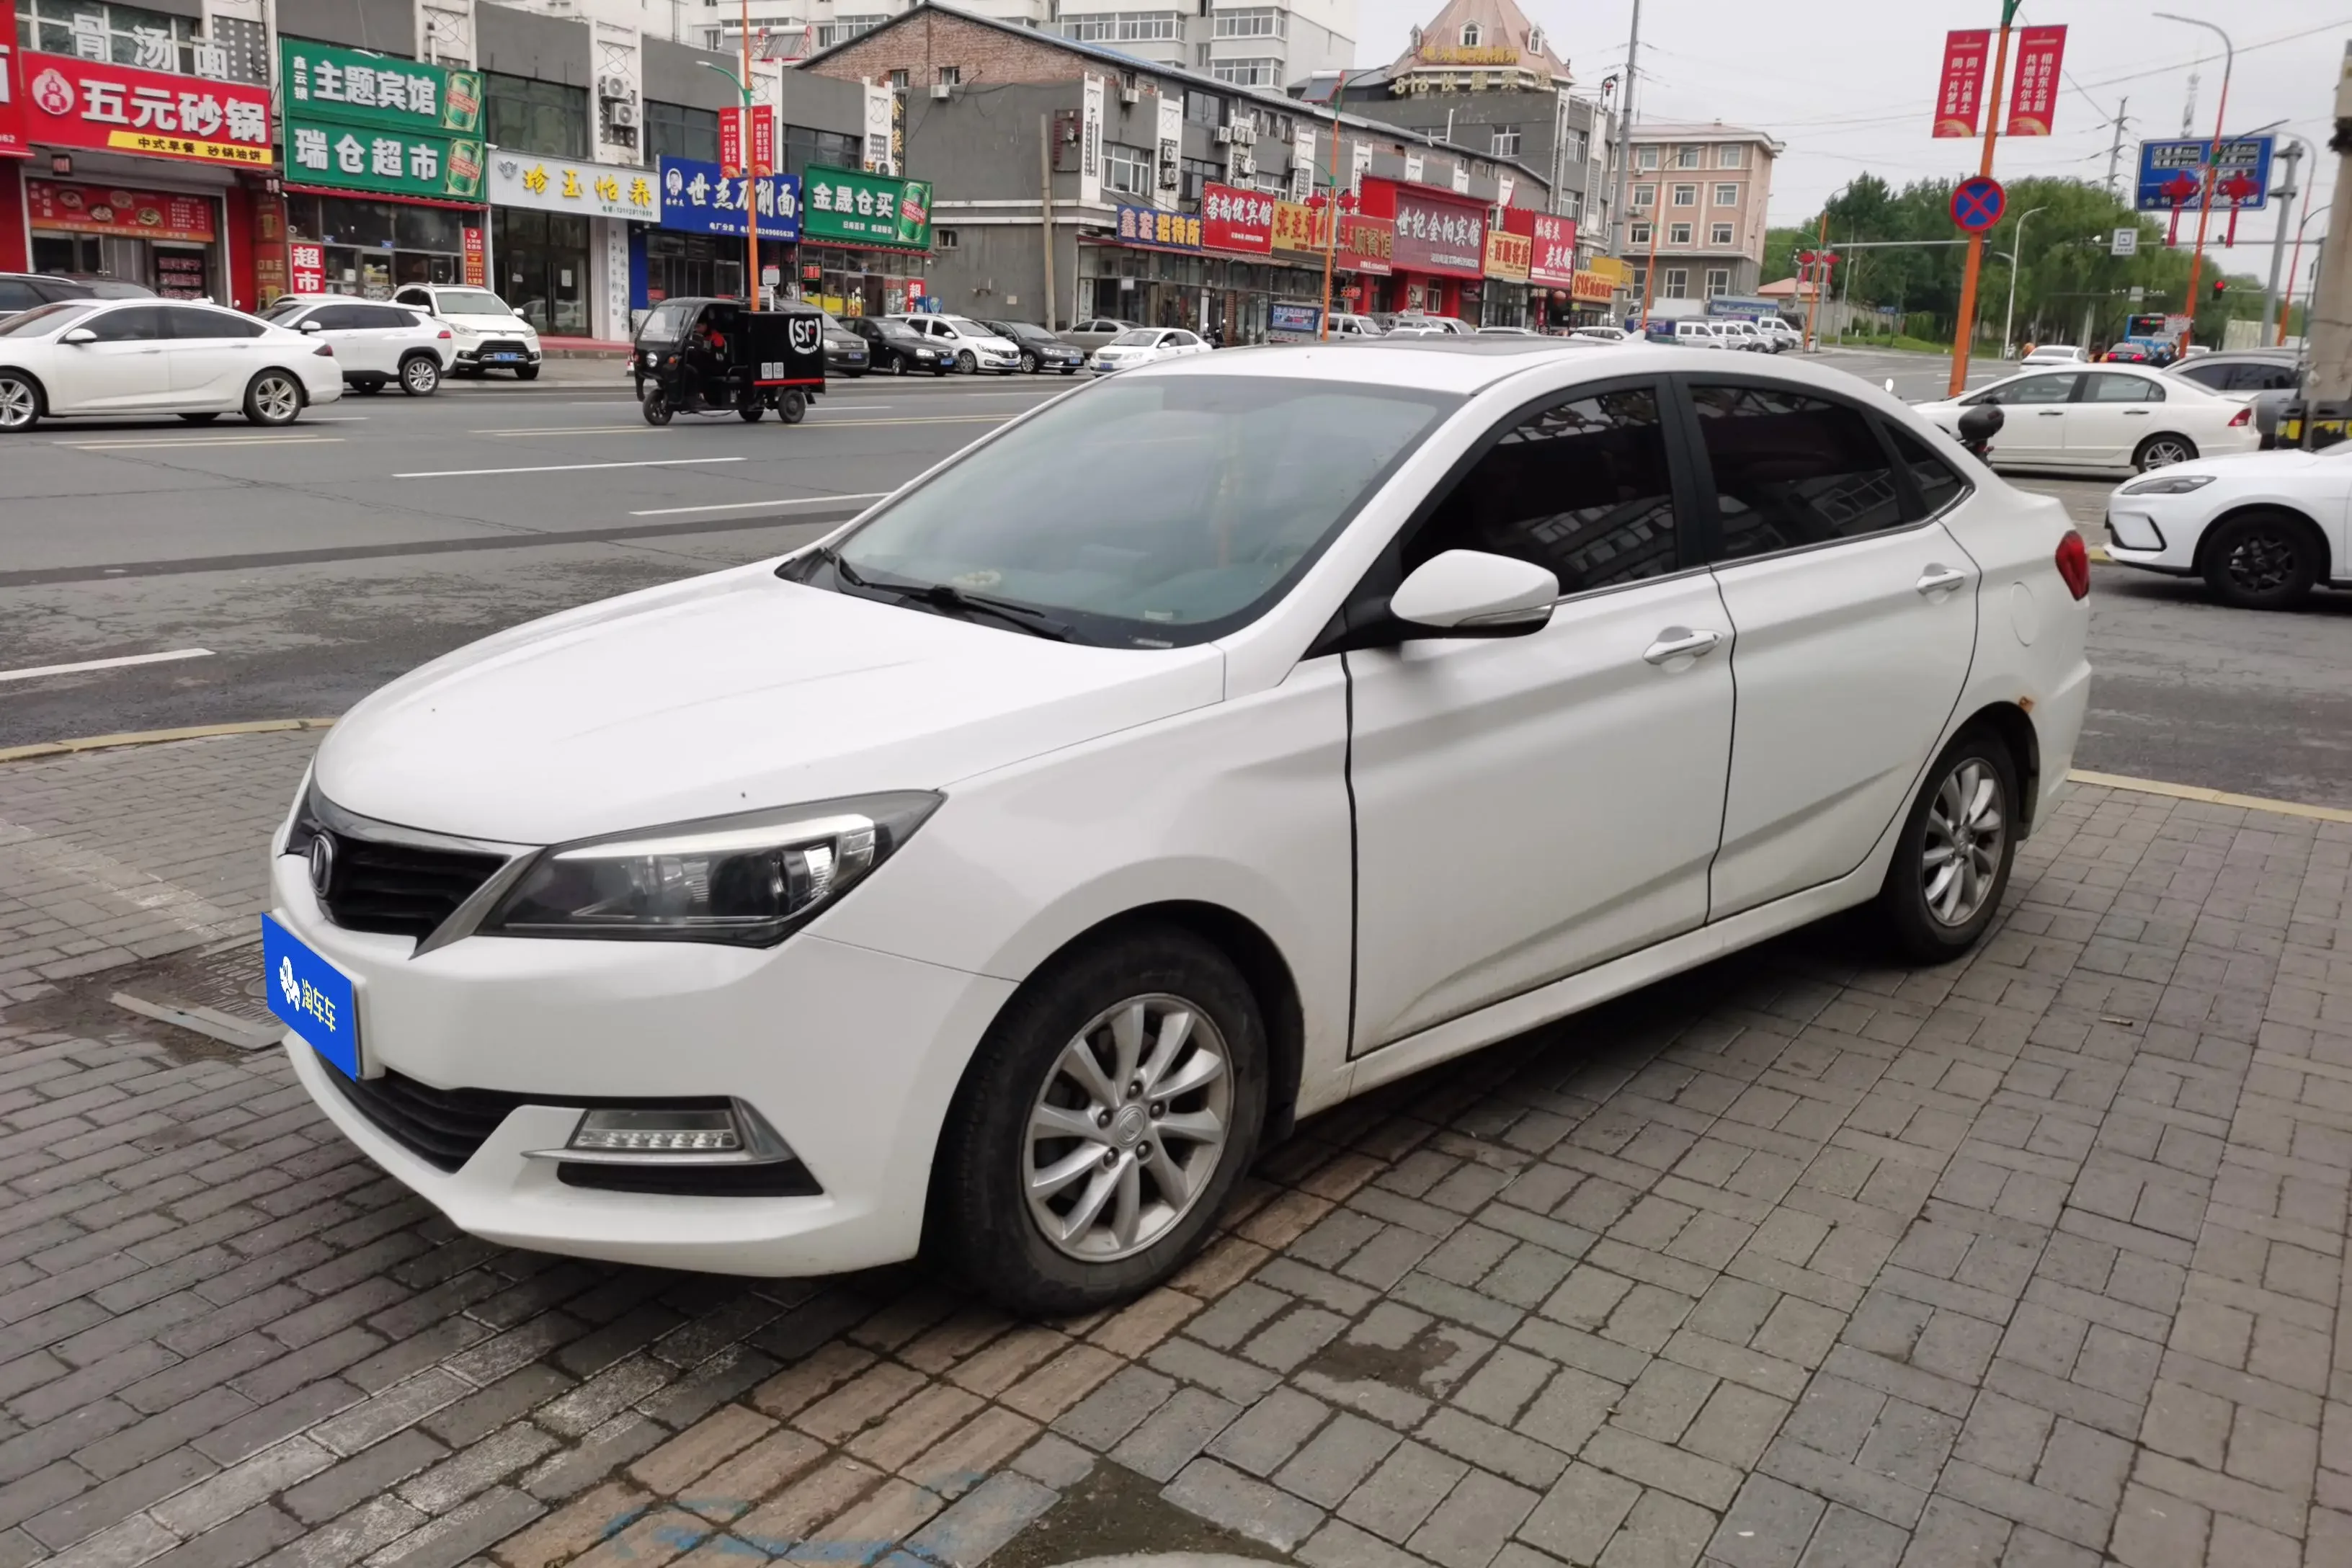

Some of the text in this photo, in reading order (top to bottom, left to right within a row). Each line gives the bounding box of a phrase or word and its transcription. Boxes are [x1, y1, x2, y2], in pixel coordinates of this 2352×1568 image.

[72, 13, 229, 79] 骨汤面
[79, 79, 267, 143] 五元砂锅
[313, 61, 437, 116] 主题宾馆
[138, 137, 262, 161] 中式早餐 砂锅油饼
[294, 128, 439, 180] 瑞仓超市
[812, 182, 895, 219] 金晟仓买
[292, 246, 323, 293] 超市
[795, 320, 816, 343] SF
